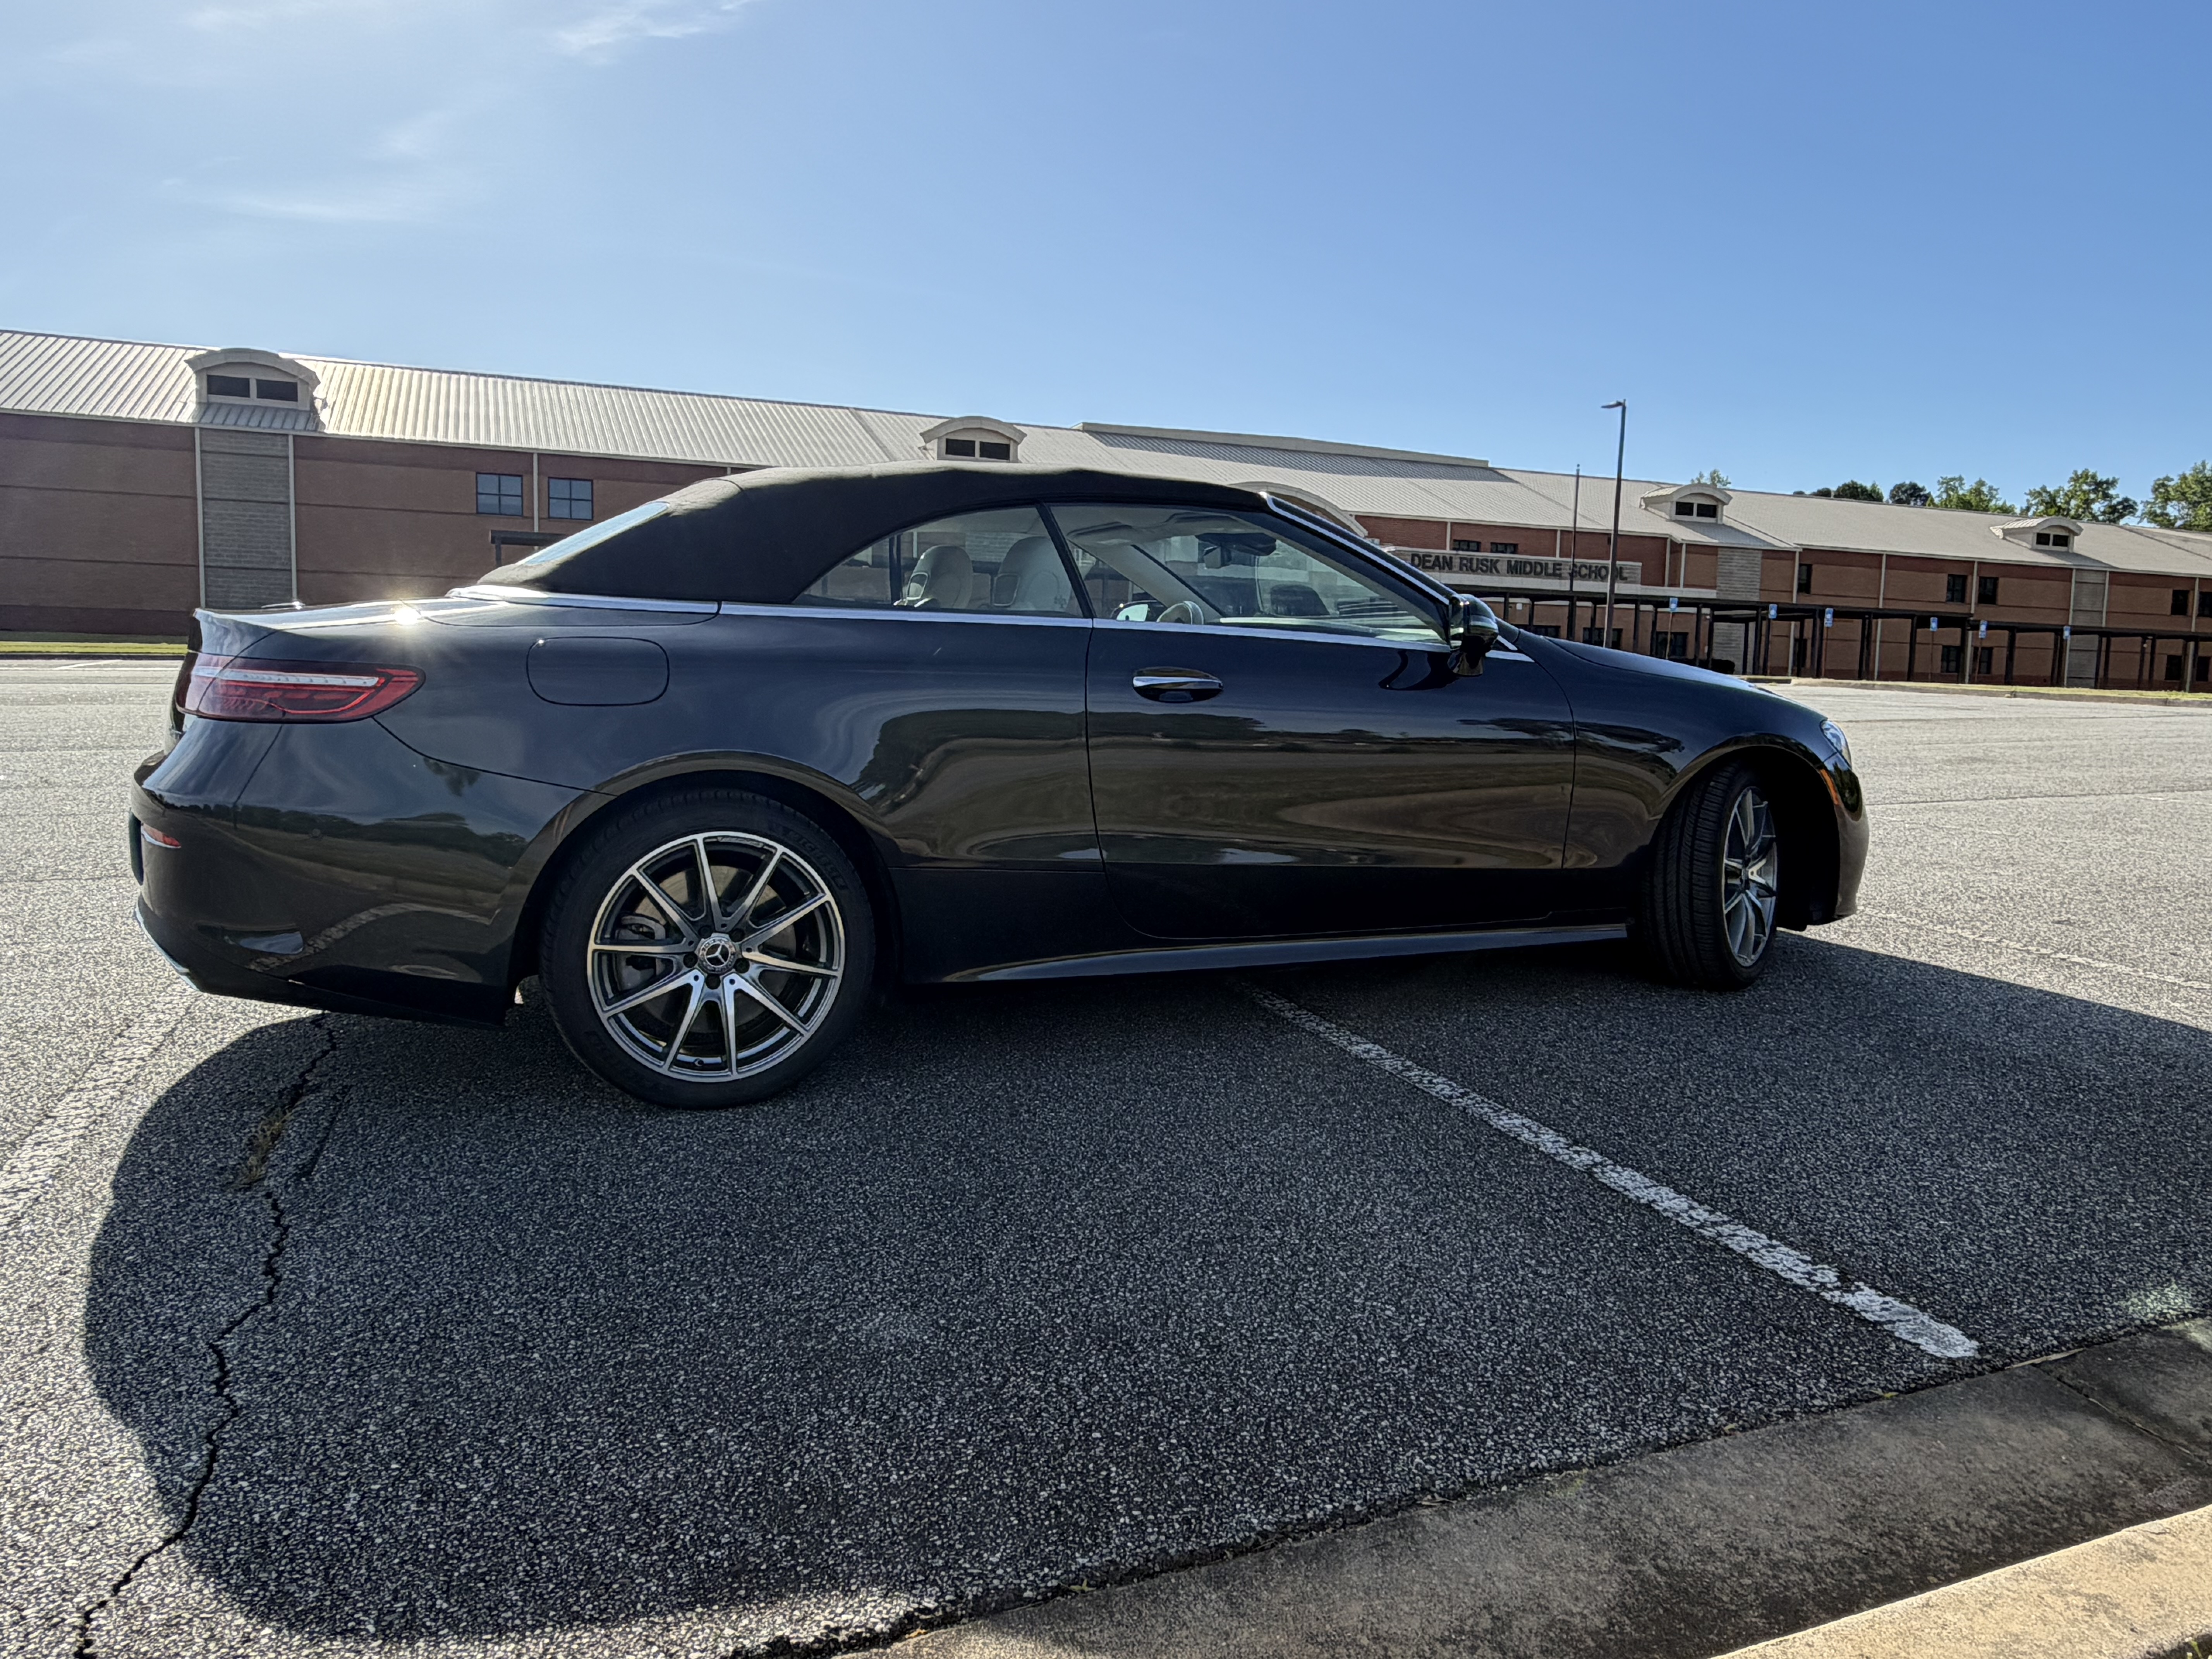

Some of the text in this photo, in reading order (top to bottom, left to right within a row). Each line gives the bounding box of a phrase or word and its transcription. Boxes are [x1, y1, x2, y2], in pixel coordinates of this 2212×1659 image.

[1410, 553, 1628, 580] DEAN RUSK MIDDLE SCHOL
